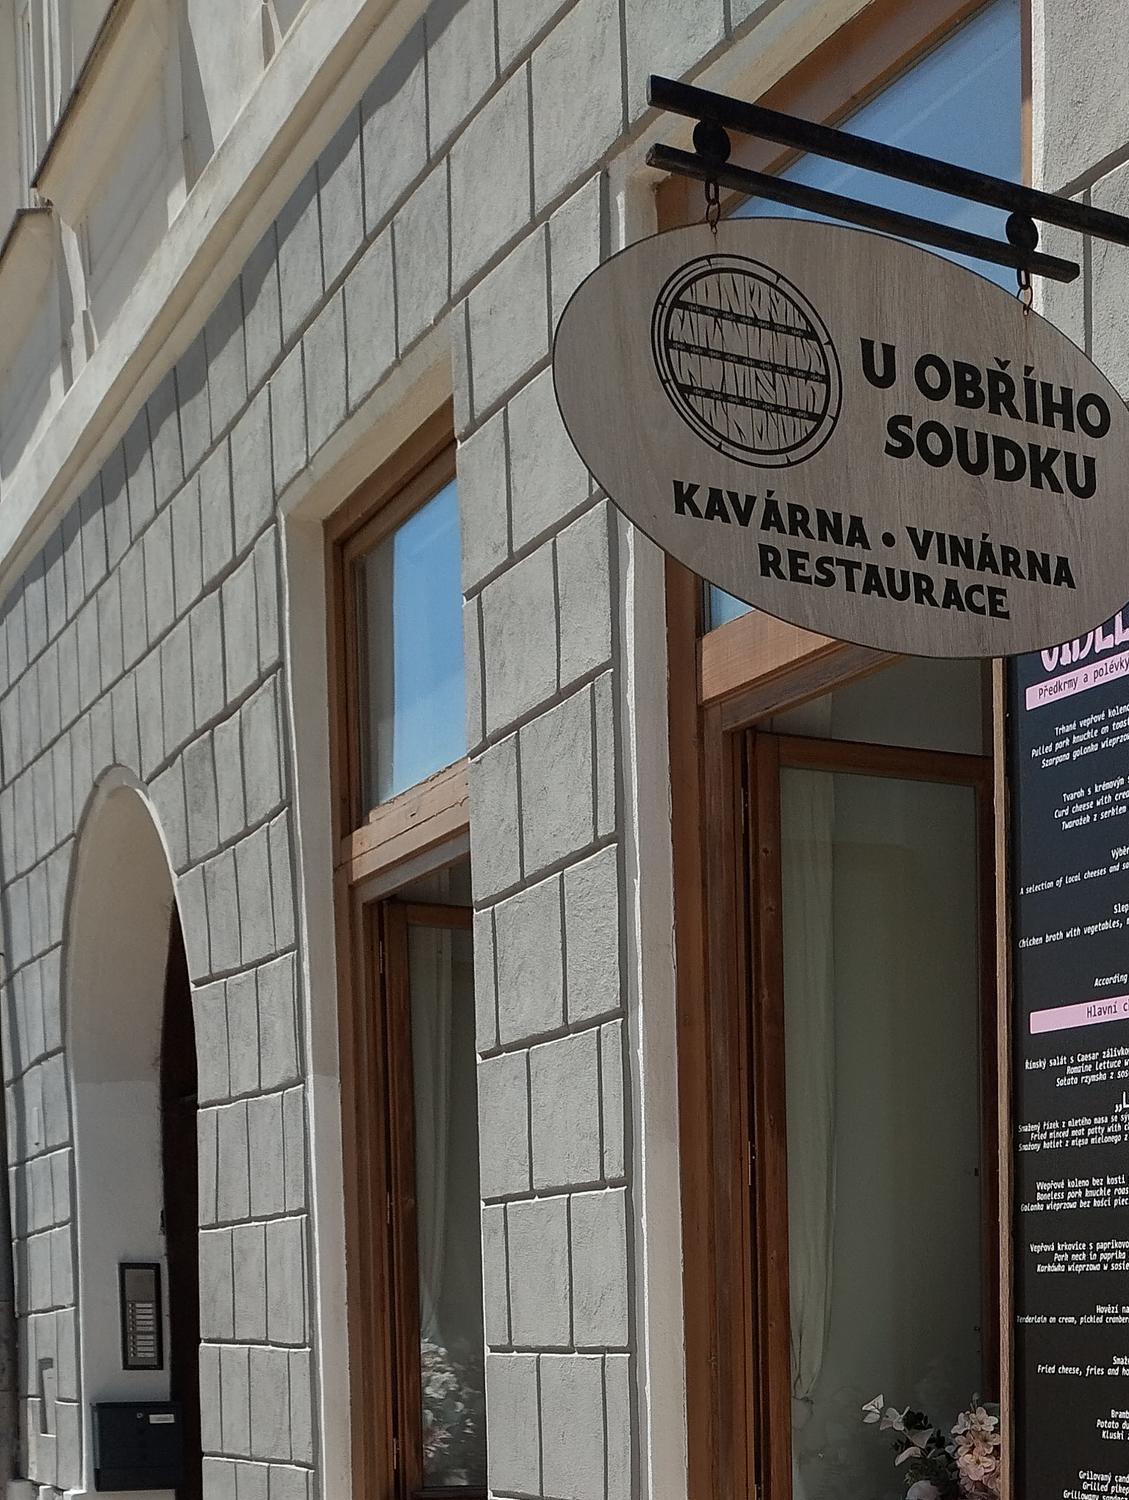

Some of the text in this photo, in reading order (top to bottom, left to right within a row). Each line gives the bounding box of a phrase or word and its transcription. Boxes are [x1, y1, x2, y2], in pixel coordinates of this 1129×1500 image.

[860, 337, 1112, 439] U OBŘÍHO
[885, 414, 1097, 499] SOUDKU
[673, 480, 1077, 589] KAVÁRNA VINÁRNA
[758, 541, 1010, 620] RESTAURACE
[1038, 677, 1077, 700] Předkrmy
[1093, 657, 1129, 683] polévky
[1087, 1001, 1117, 1018] Hlavní
